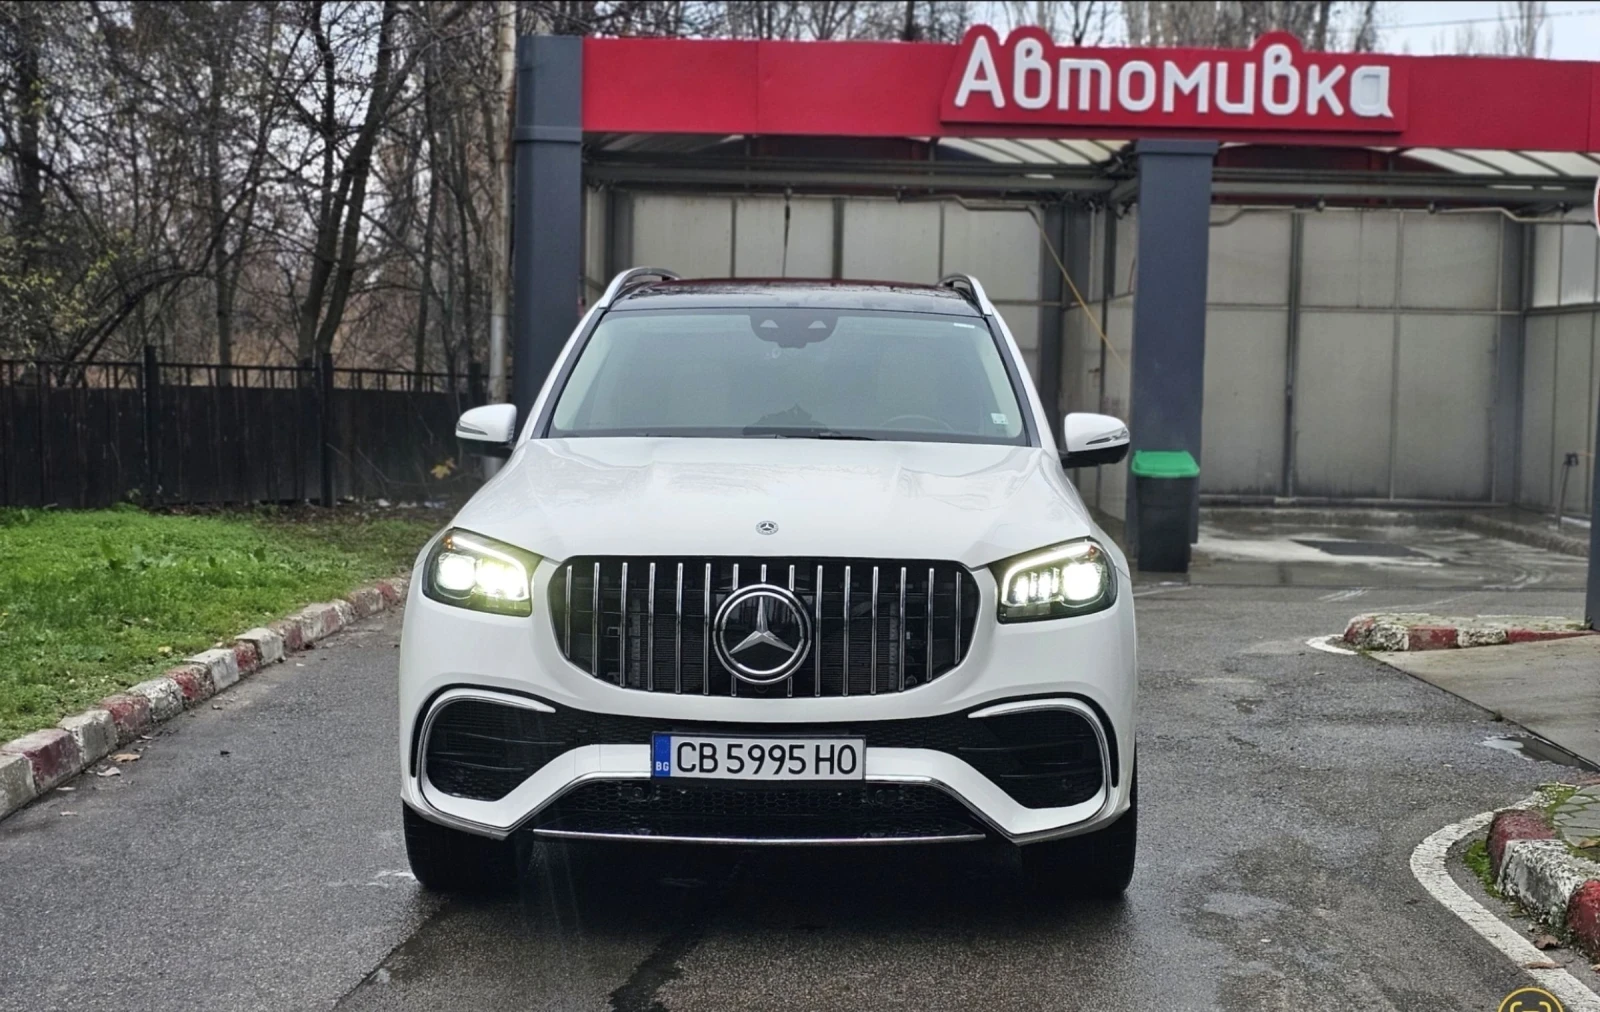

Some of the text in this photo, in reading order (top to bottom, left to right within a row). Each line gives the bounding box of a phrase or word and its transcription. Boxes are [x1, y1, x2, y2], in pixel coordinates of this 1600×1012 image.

[954, 35, 1394, 118] Автомивка
[655, 761, 669, 772] BG
[676, 741, 719, 773] CB
[726, 743, 807, 775] 5995
